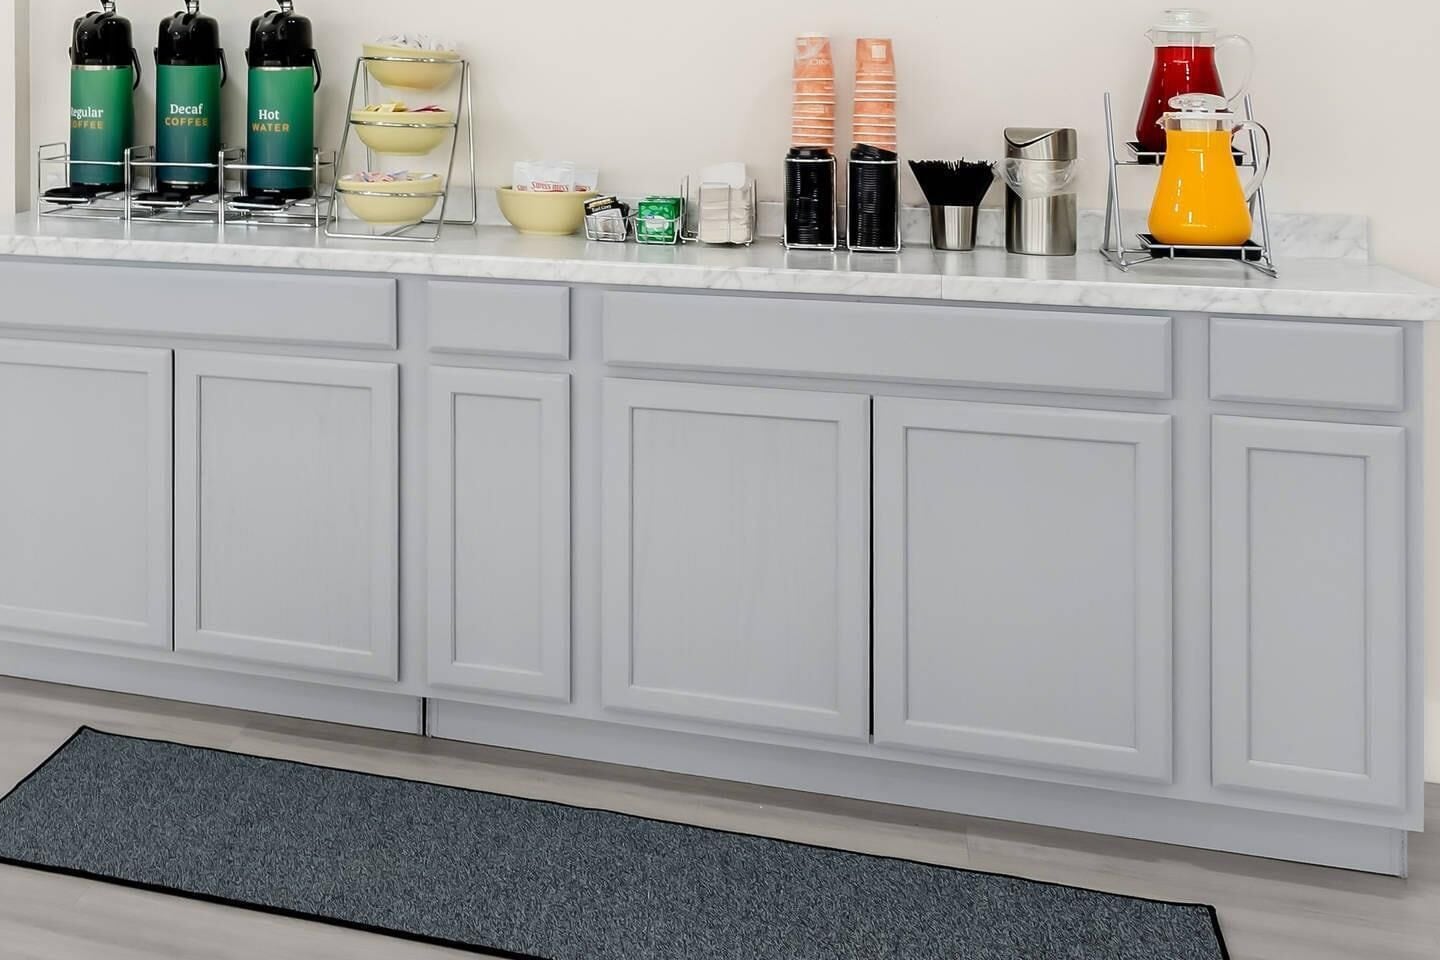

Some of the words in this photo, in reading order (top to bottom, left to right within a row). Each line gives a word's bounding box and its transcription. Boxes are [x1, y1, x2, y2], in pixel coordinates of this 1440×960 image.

[170, 103, 203, 115] Decaf
[258, 109, 280, 120] Hot
[71, 120, 104, 129] OFFEE
[164, 117, 208, 127] COFFEE
[251, 123, 289, 132] WATER
